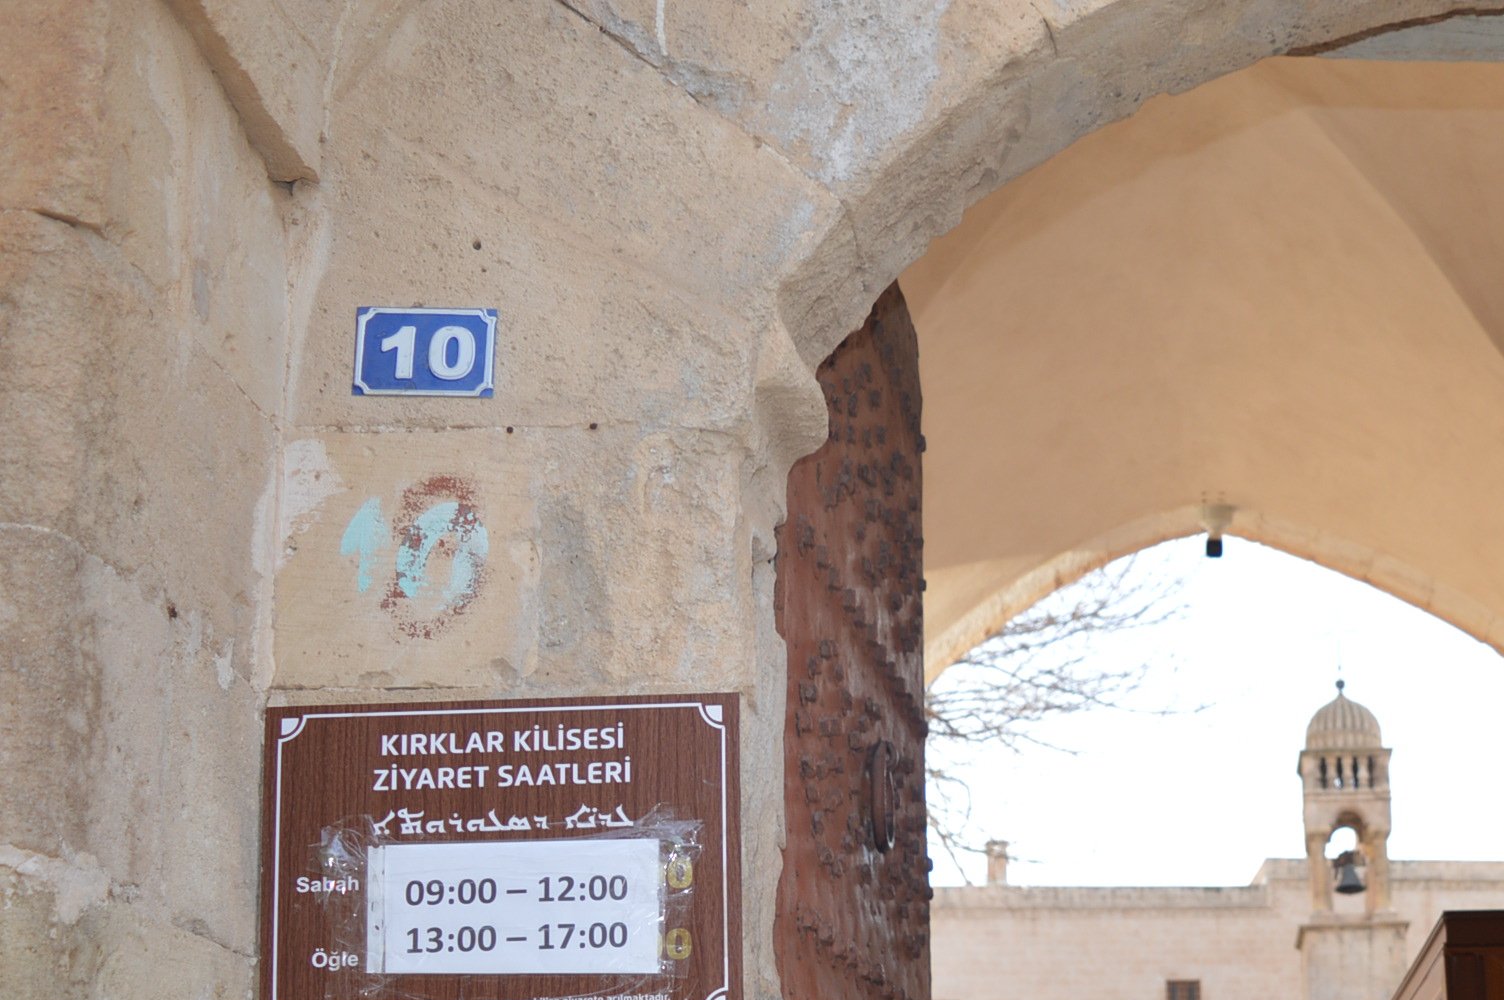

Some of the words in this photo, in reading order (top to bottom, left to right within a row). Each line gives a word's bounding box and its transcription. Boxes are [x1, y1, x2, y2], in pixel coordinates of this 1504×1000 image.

[381, 326, 477, 380] 10
[381, 731, 505, 756] KIRKLAR
[514, 721, 624, 752] KİLİSESİ
[372, 763, 490, 792] ZİYARET
[497, 755, 632, 788] SAATLERİ
[296, 875, 360, 894] Sabah
[405, 878, 498, 906] 09:00
[537, 874, 628, 902] 12:00
[406, 925, 498, 954] 13:00
[537, 921, 628, 950] 17:00
[311, 947, 359, 971] Öğle
